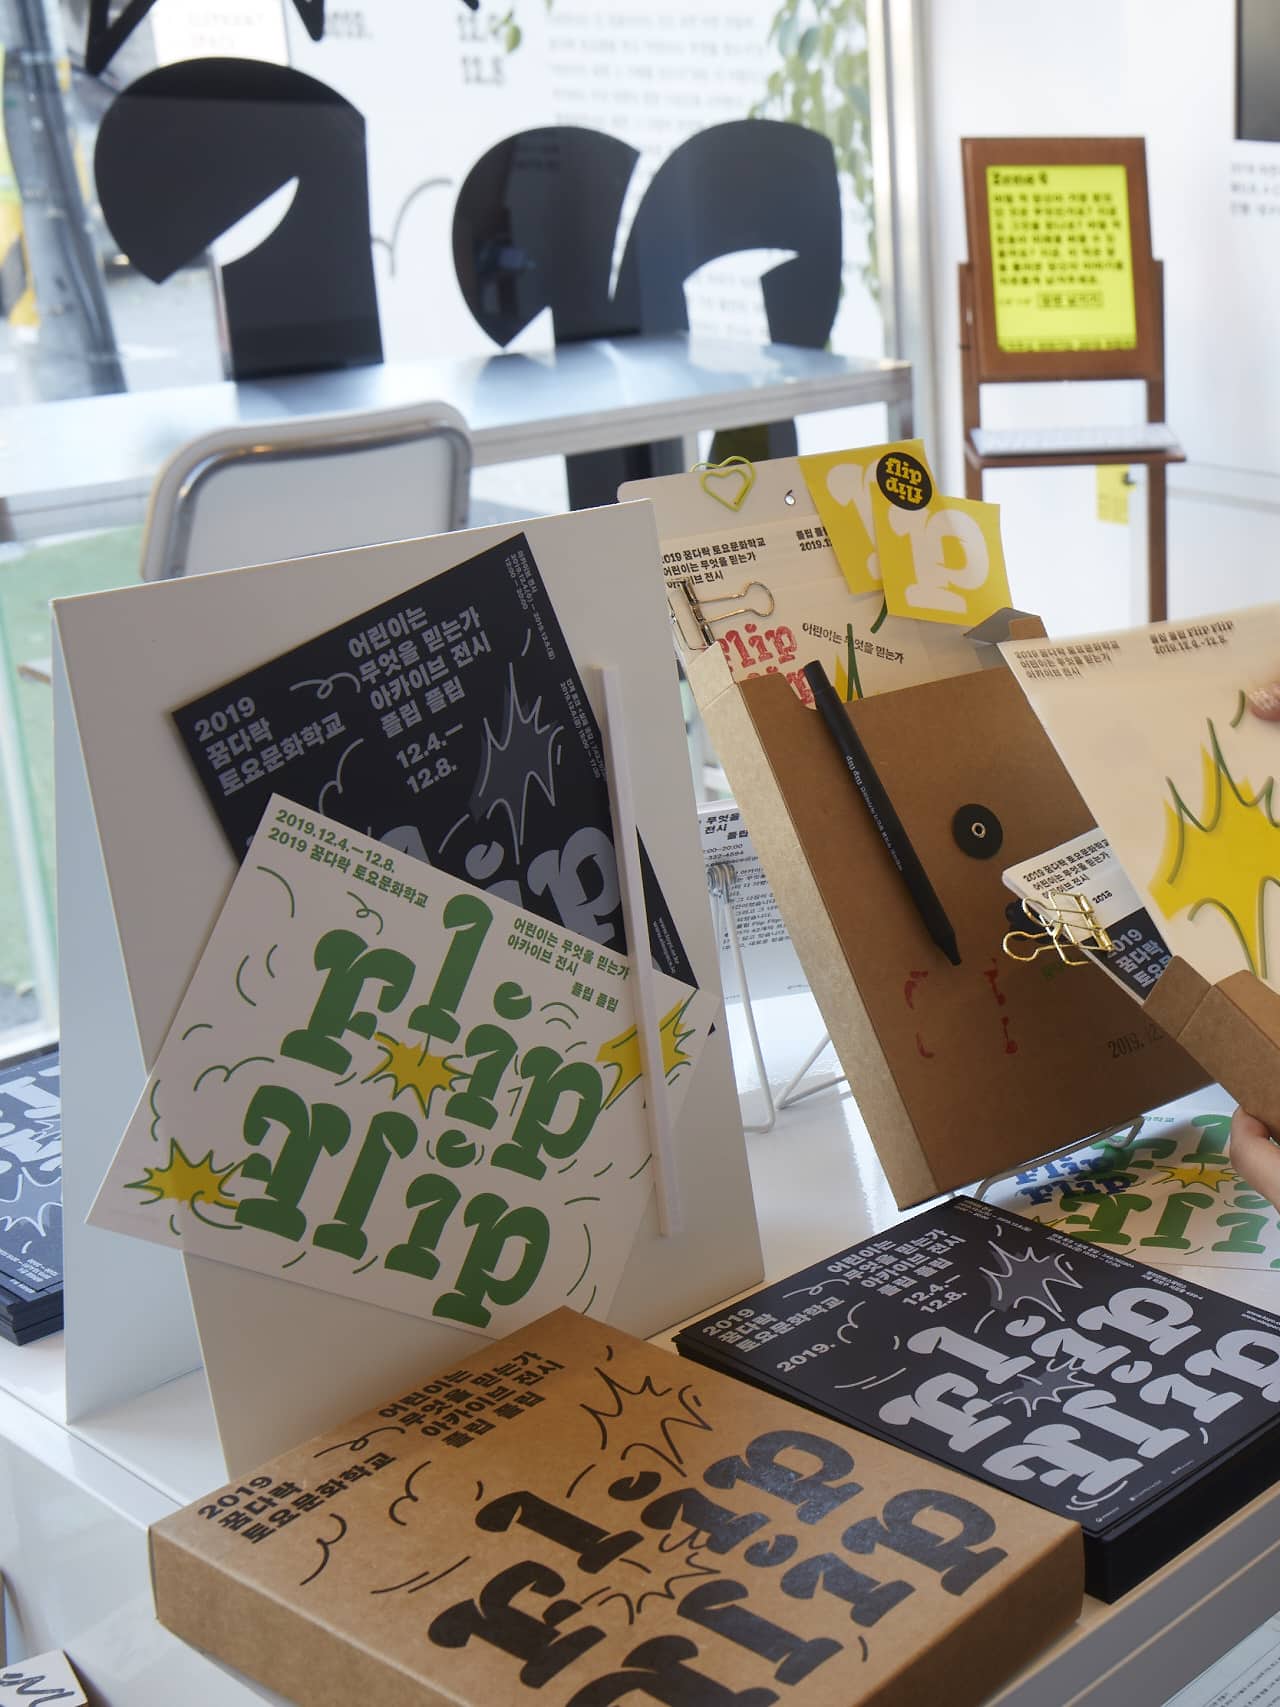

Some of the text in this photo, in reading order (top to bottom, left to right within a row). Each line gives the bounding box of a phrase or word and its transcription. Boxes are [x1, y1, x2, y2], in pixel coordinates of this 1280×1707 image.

[664, 560, 699, 577] 어린이는
[700, 555, 728, 571] 무엇을
[728, 551, 757, 566] 믿는가
[683, 546, 711, 561] 꿈다락
[712, 537, 766, 555] 토요문화학교
[704, 570, 724, 583] 전시
[349, 608, 428, 658] 어린이는
[359, 606, 481, 684] 무엇을 믿는가
[802, 622, 842, 646] 어린이는
[875, 645, 904, 665] 믿는가
[370, 630, 492, 710] 아카이브 전시
[195, 697, 255, 740] 2019
[379, 675, 466, 739] 플립 플립
[205, 717, 273, 770] 꿈다락
[217, 712, 346, 797] 토요문화학교
[406, 758, 458, 794] 12.8.
[705, 824, 727, 835] 전시
[706, 813, 740, 825] 무엇을
[267, 827, 429, 908] 2019 꿈다락 토요문화학교
[507, 934, 579, 977] 아카이브 전시
[513, 918, 630, 981] 어린이는 무엇을 믿는가
[570, 981, 619, 1013] 플립 플립
[827, 1240, 897, 1274] 어린이는
[843, 1228, 948, 1281] 무엇을 믿는가
[860, 1235, 967, 1288] 아카이브 전시
[877, 1258, 955, 1297] 플립 플립
[702, 1308, 755, 1337] 2019
[735, 1295, 845, 1352] 토요문화학교
[919, 1290, 968, 1314] 12.8.
[718, 1312, 779, 1344] 꿈다락
[776, 1343, 836, 1373] 2019.
[378, 1370, 474, 1418] 어린이는
[398, 1351, 542, 1426] 무엇을 믿는가
[421, 1359, 566, 1436] 아카이브 전시
[441, 1390, 547, 1449] 플립 플립
[198, 1476, 273, 1520] 2019
[218, 1481, 303, 1531] 꿈다락
[240, 1452, 397, 1544] 토요문화학교
